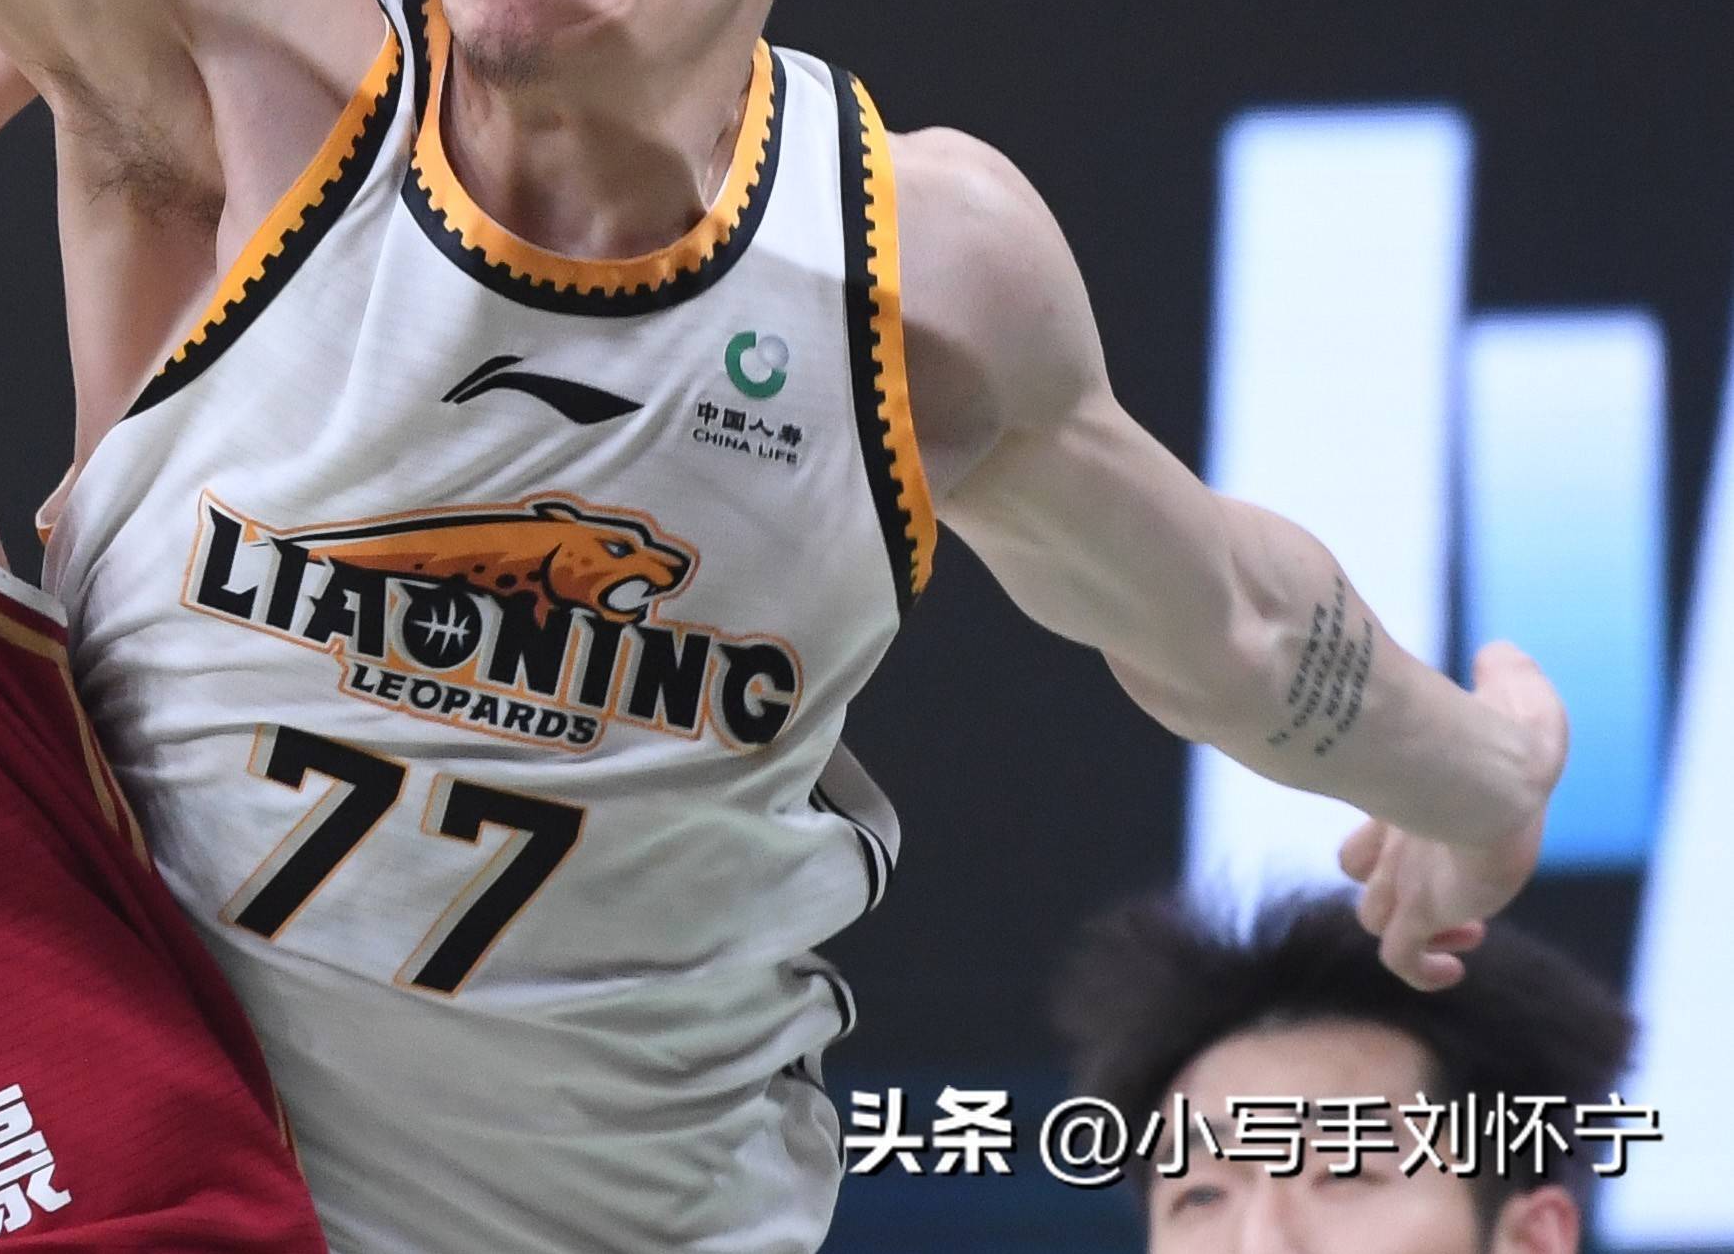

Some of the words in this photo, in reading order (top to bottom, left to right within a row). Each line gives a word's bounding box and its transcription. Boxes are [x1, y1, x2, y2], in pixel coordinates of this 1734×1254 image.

[692, 427, 752, 455] CHINA
[757, 441, 798, 465] LIFE
[696, 401, 803, 448] 中国人寿
[188, 498, 802, 747] LIAONING
[346, 660, 600, 747] LEOPARDS
[221, 723, 588, 998] 77
